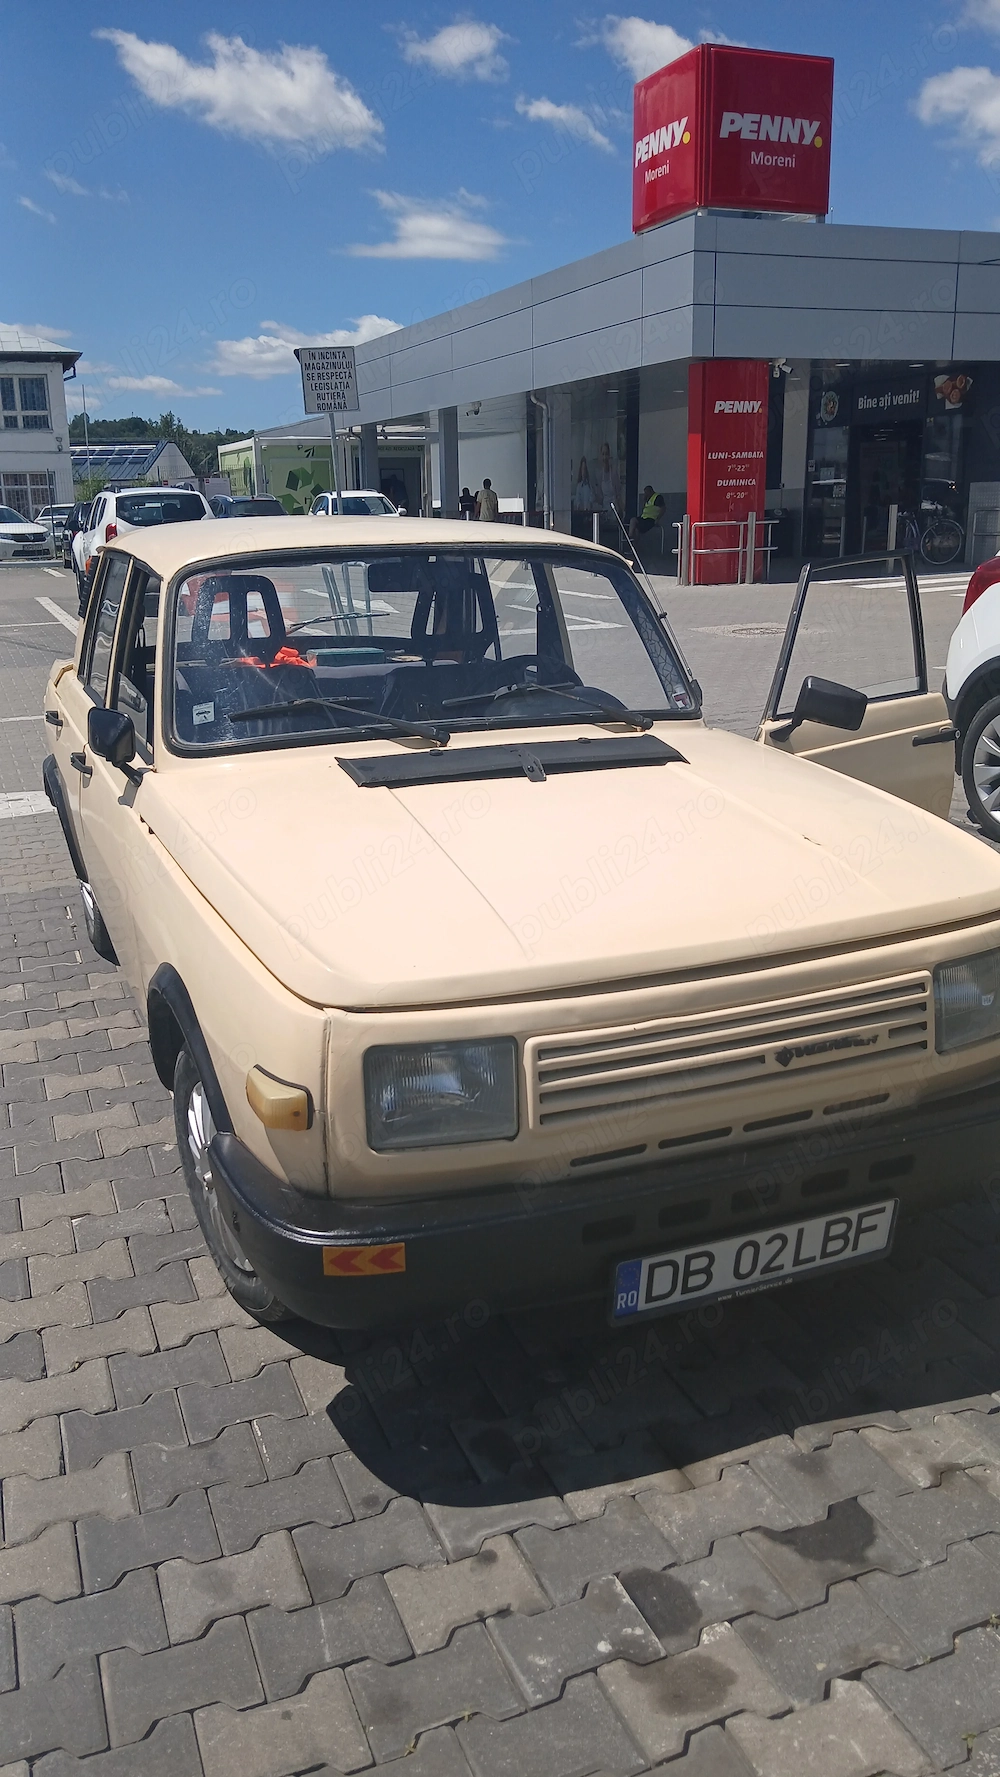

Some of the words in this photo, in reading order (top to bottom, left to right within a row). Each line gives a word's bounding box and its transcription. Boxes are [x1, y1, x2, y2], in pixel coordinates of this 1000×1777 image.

[750, 151, 796, 168] Moreni
[644, 160, 670, 184] Moreni
[308, 350, 316, 360] ÎN
[318, 351, 346, 360] INCINTA
[304, 361, 353, 371] MAGAZINULUI
[306, 372, 316, 381] SE
[317, 369, 353, 381] RESPECTĂ
[316, 390, 347, 401] RUTIERĂ
[858, 395, 878, 410] Bine
[892, 389, 920, 406] venit!
[317, 400, 347, 411] ROMÂNĂ
[707, 451, 764, 460] LUNI-SAMBATA
[716, 478, 757, 487] DUMINICA
[644, 1250, 716, 1305] DB
[616, 1289, 638, 1310] RO
